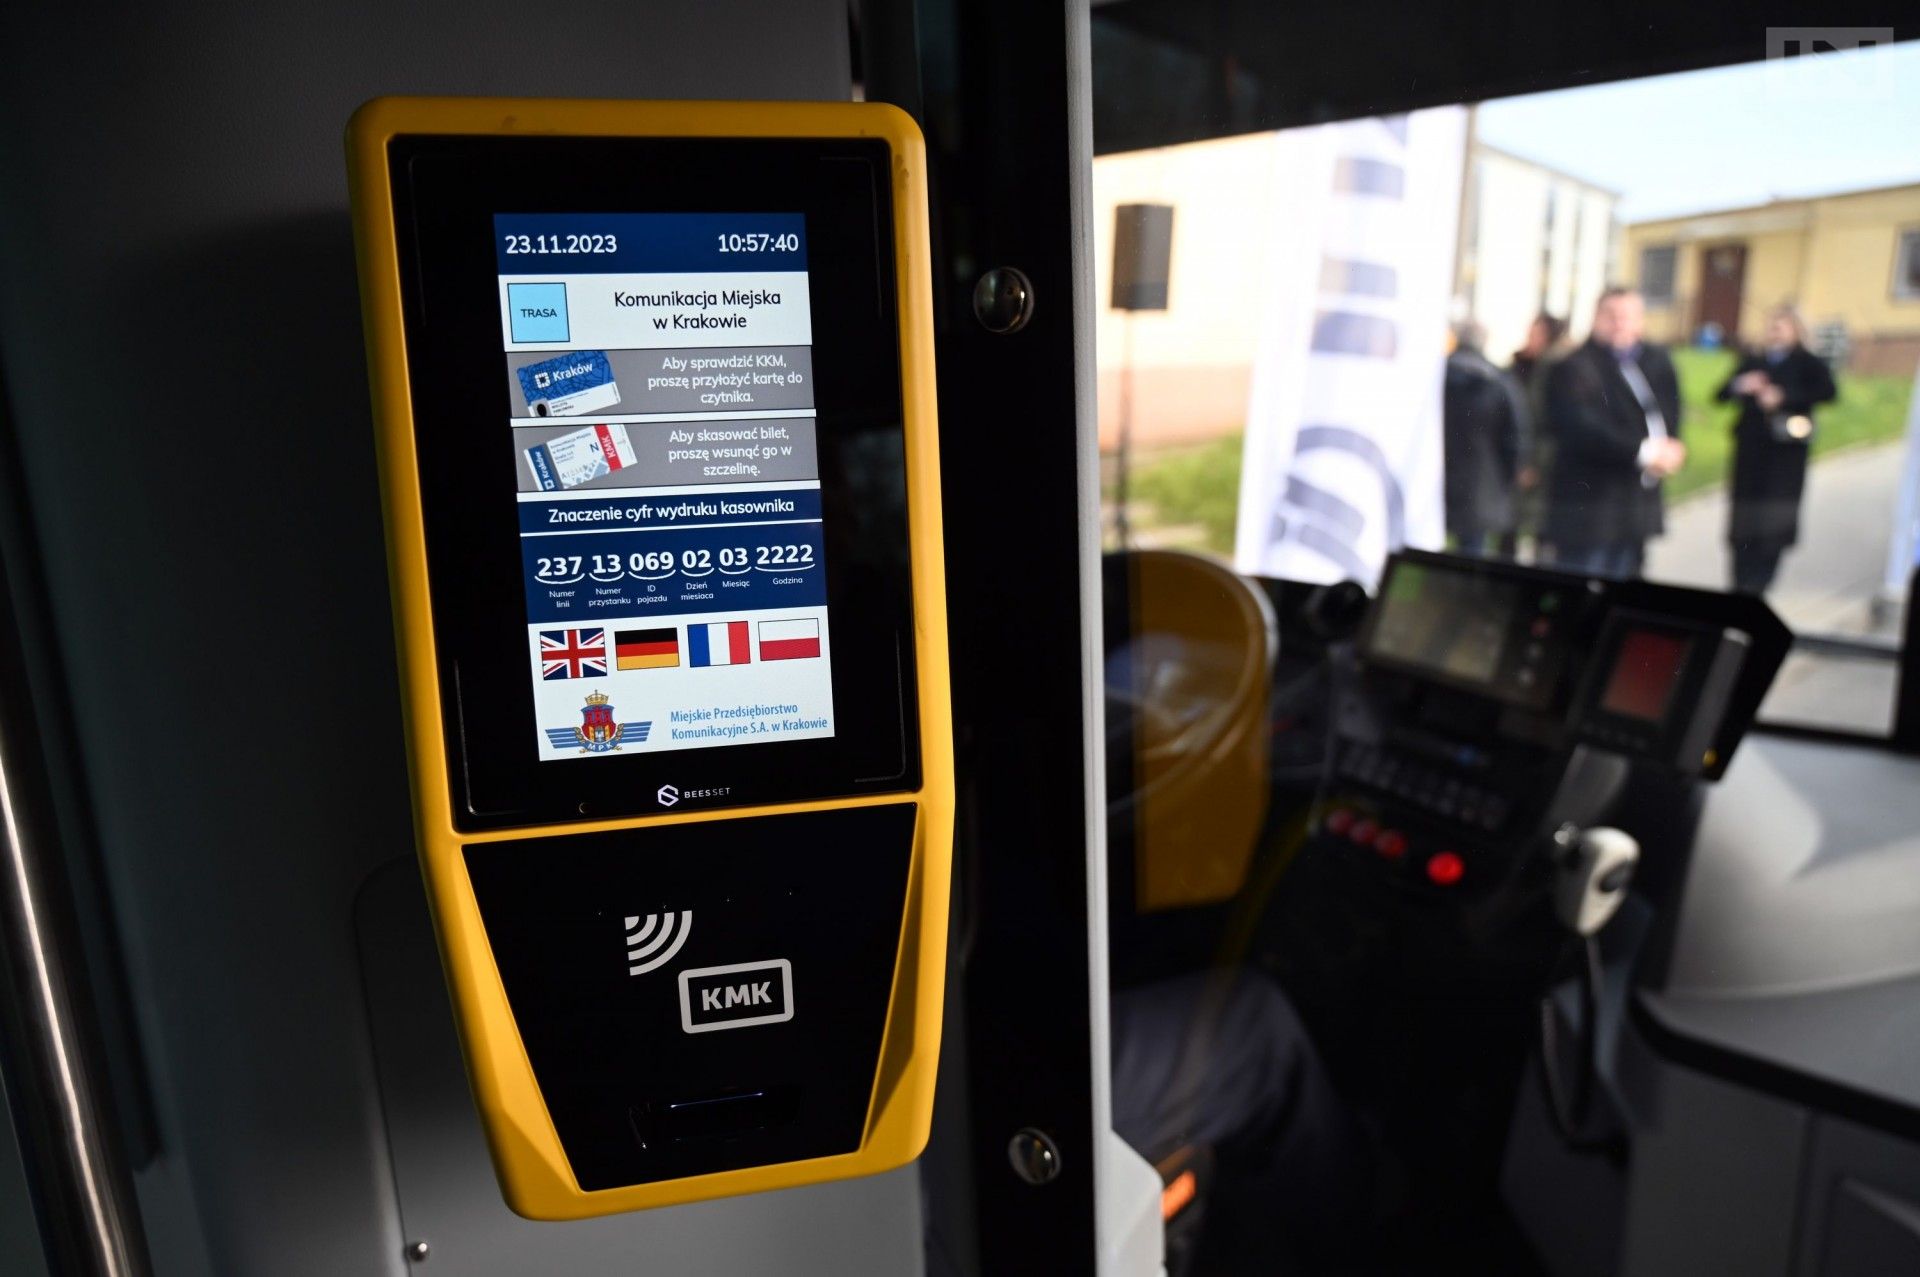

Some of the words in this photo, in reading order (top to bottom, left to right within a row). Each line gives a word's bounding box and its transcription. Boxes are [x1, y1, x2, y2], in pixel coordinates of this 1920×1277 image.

[504, 234, 618, 254] 23.11.2023
[718, 233, 799, 253] 10:57:40
[614, 290, 718, 310] Komunikacja
[722, 289, 781, 309] Miejska
[520, 308, 558, 318] TRASA
[652, 318, 668, 329] w
[673, 313, 747, 329] Krakowie
[662, 356, 687, 372] Aby
[690, 355, 754, 371] sprawdzić
[756, 354, 787, 368] KKM,
[552, 363, 593, 382] Kraków
[647, 377, 689, 391] proszę
[692, 373, 751, 389] przyłożyć
[753, 372, 785, 387] kartę
[787, 371, 803, 384] do
[700, 391, 755, 406] czytnika.
[669, 429, 695, 445] Aby
[697, 426, 758, 442] skasować
[760, 426, 790, 440] bilet,
[589, 442, 600, 453] N
[601, 435, 616, 459] KMK
[668, 450, 710, 463] proszę
[712, 445, 760, 460] wsunąć
[762, 446, 778, 459] go
[780, 445, 793, 456] w
[703, 463, 761, 476] szczelinę.
[548, 506, 623, 523] Znaczenie
[625, 505, 653, 523] cyfr
[656, 501, 717, 521] wydruku
[720, 499, 795, 515] kasownika
[537, 556, 582, 577] 237
[592, 554, 622, 574] 13
[629, 551, 675, 572] 069
[682, 549, 712, 569] 02
[719, 547, 748, 567] 03
[756, 544, 814, 565] 2222
[647, 584, 656, 593] ID
[686, 581, 708, 591] Dzień
[772, 576, 803, 585] Godzina
[549, 590, 576, 598] Numer
[595, 587, 622, 595] Numer
[637, 594, 668, 605] pojazdu
[556, 600, 570, 608] linii
[588, 597, 632, 607] przystanku
[670, 709, 712, 724] Miejskie
[714, 703, 798, 719] Przedsiębiorstwo
[672, 725, 749, 740] Komunikacyjne
[751, 721, 769, 734] S.A.
[771, 723, 780, 732] w
[783, 717, 828, 731] Krakowie
[701, 981, 772, 1011] KMK
